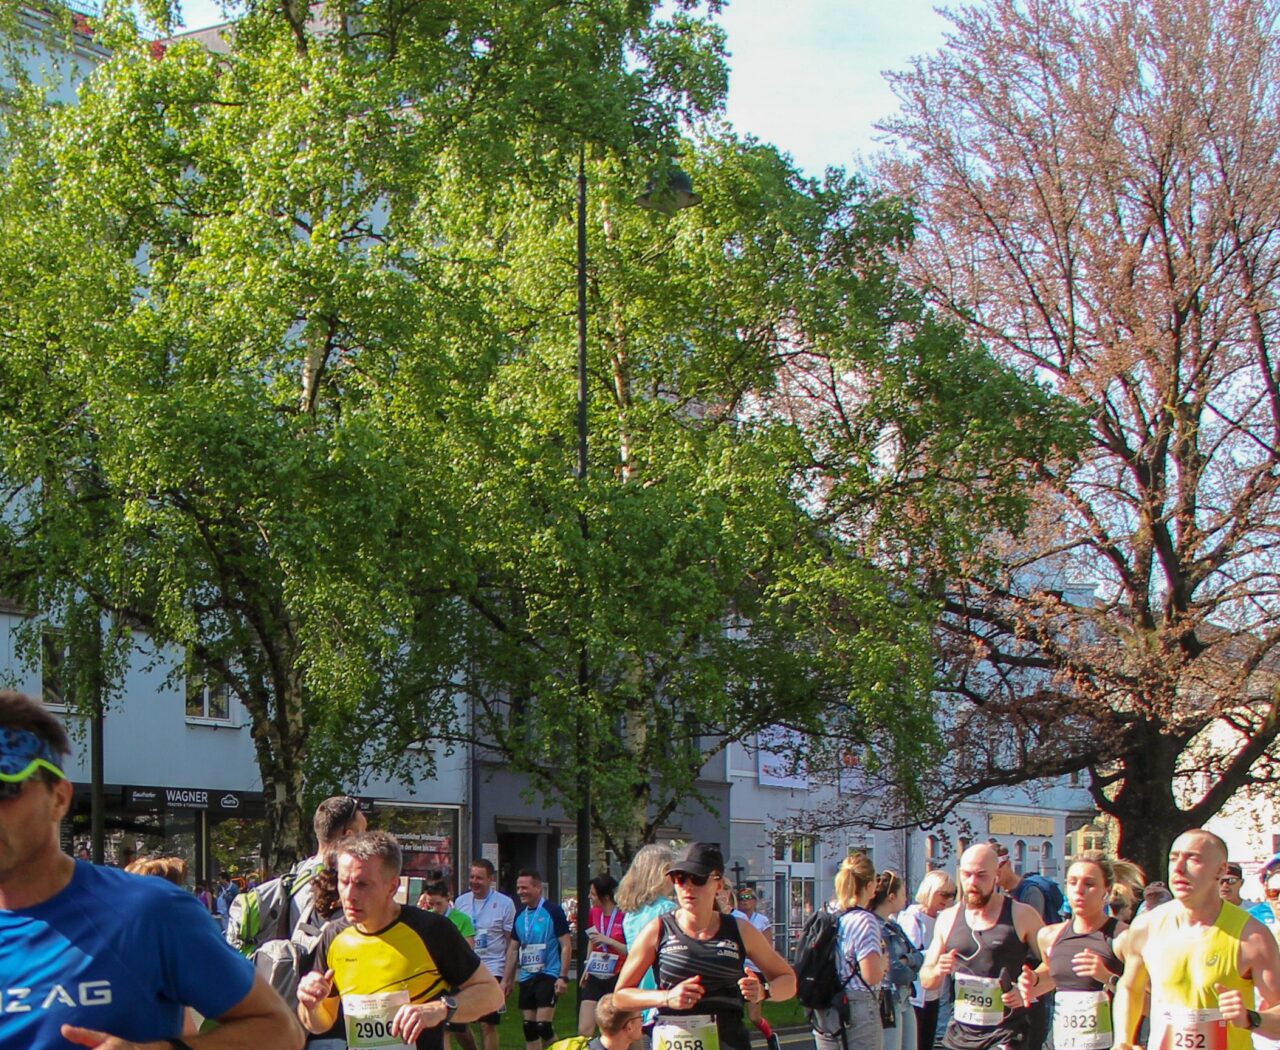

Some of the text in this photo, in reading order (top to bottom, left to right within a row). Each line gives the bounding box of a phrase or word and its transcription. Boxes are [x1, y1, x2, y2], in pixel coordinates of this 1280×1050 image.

[165, 789, 208, 803] WAGNER
[41, 980, 112, 1010] AG
[964, 993, 993, 1008] 5299
[1063, 1014, 1097, 1028] 3823
[1175, 1032, 1206, 1049] 252
